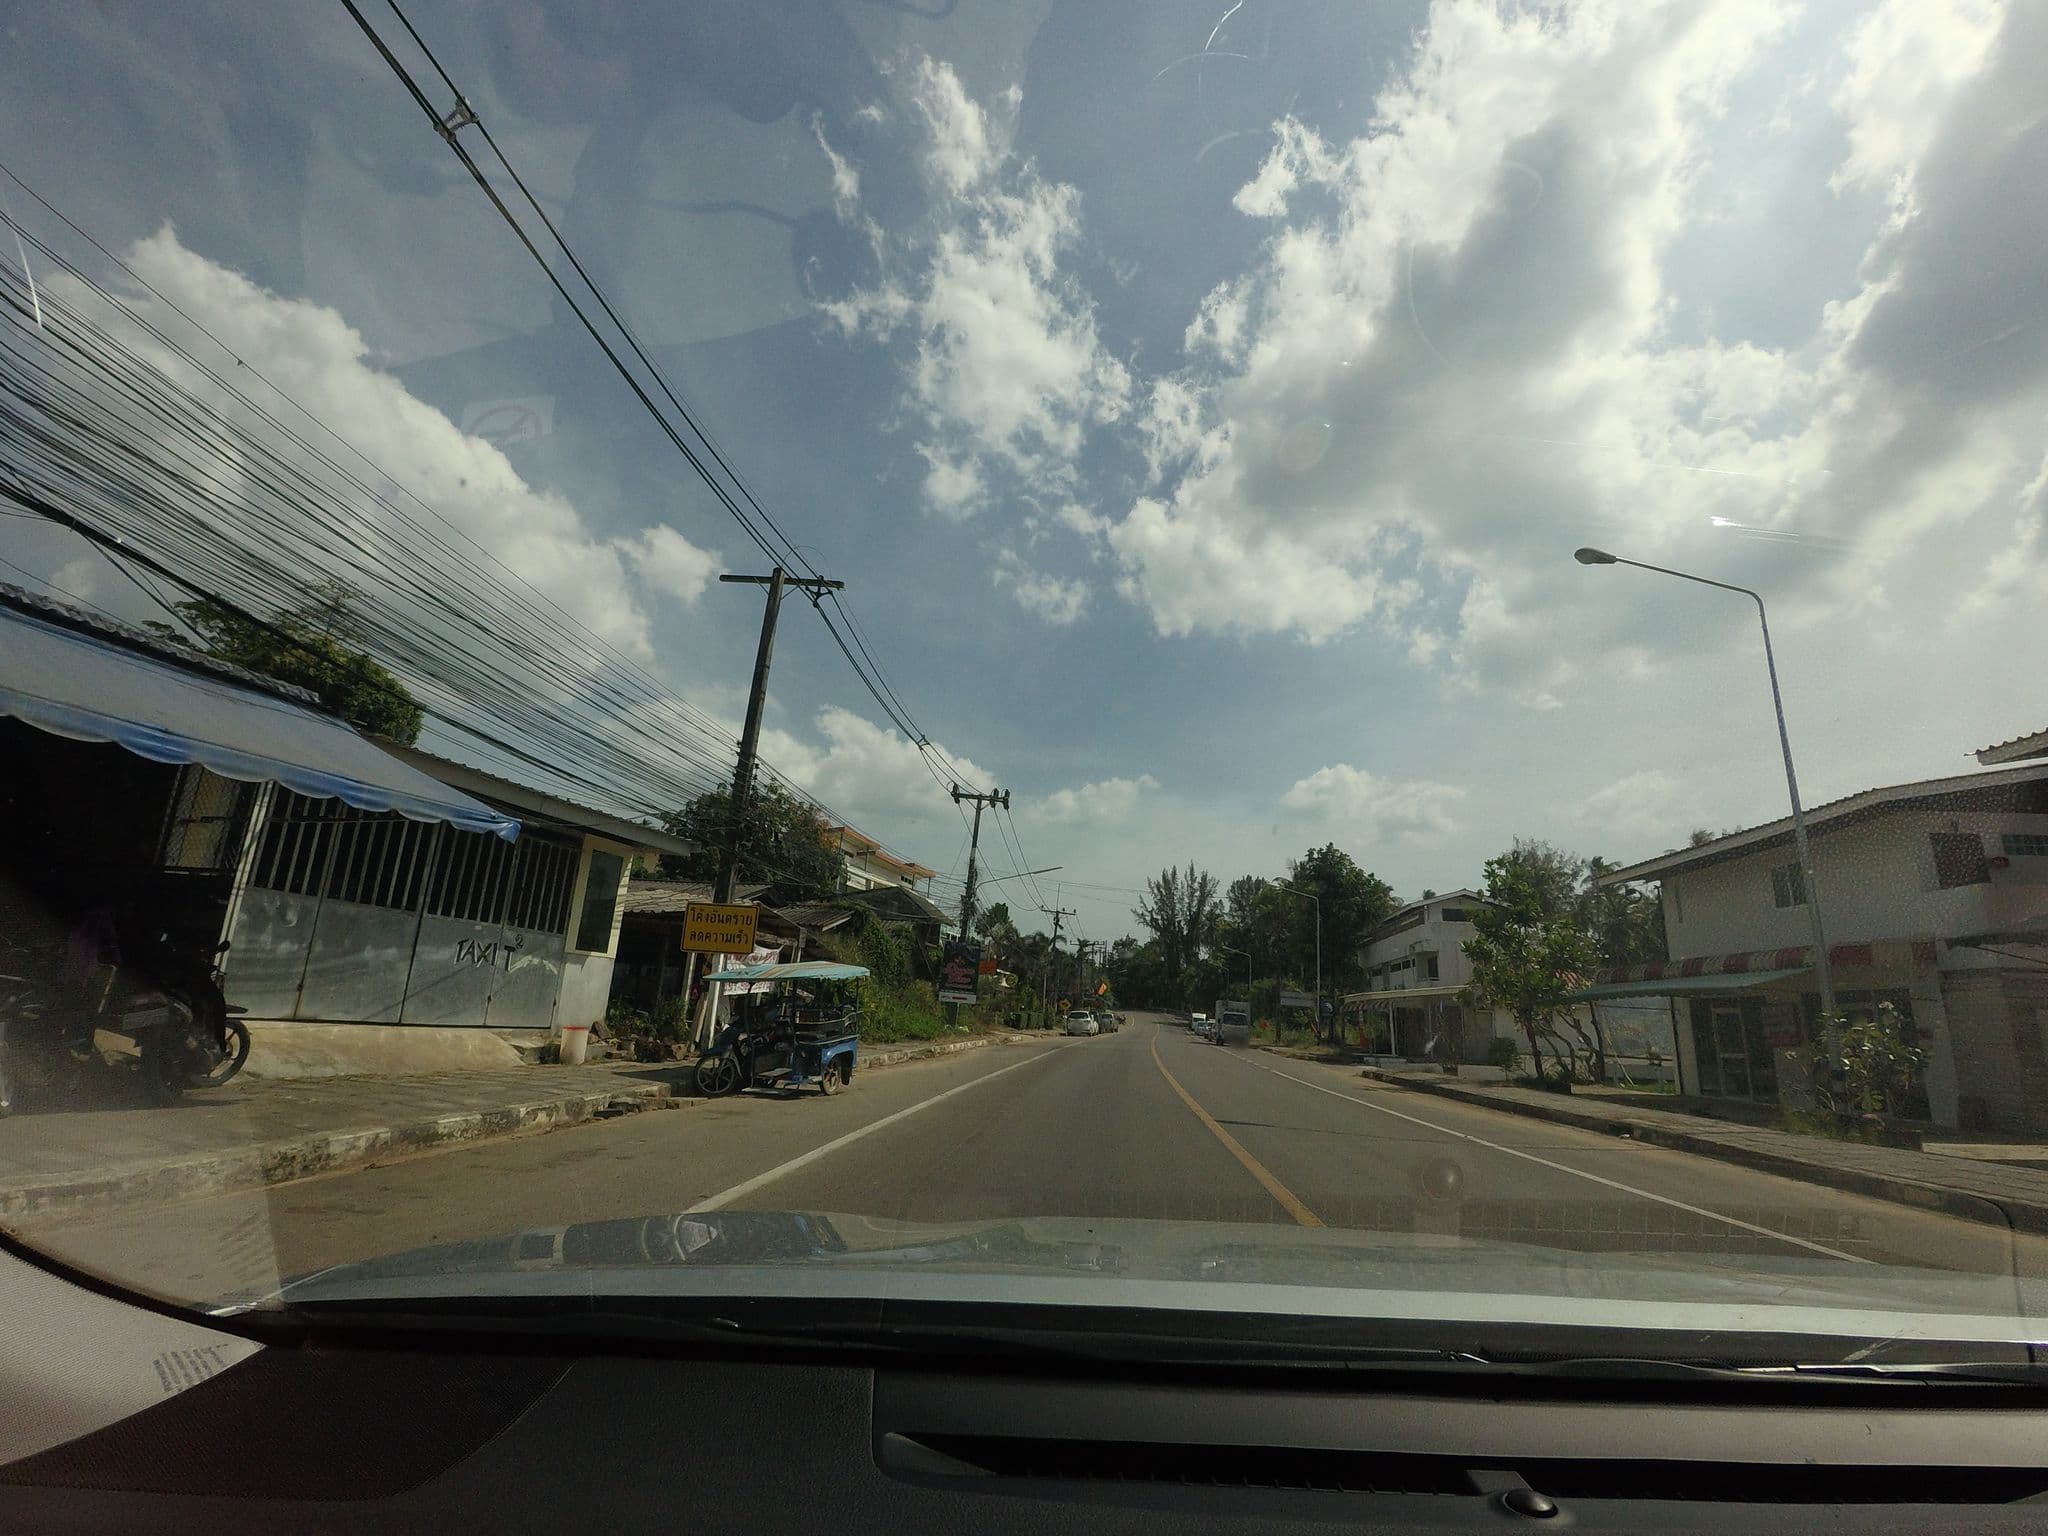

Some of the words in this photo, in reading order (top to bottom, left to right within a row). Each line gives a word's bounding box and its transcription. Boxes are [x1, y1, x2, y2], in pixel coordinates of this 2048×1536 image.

[689, 929, 749, 945] ลดความเร็ว
[454, 938, 498, 967] TAXI
